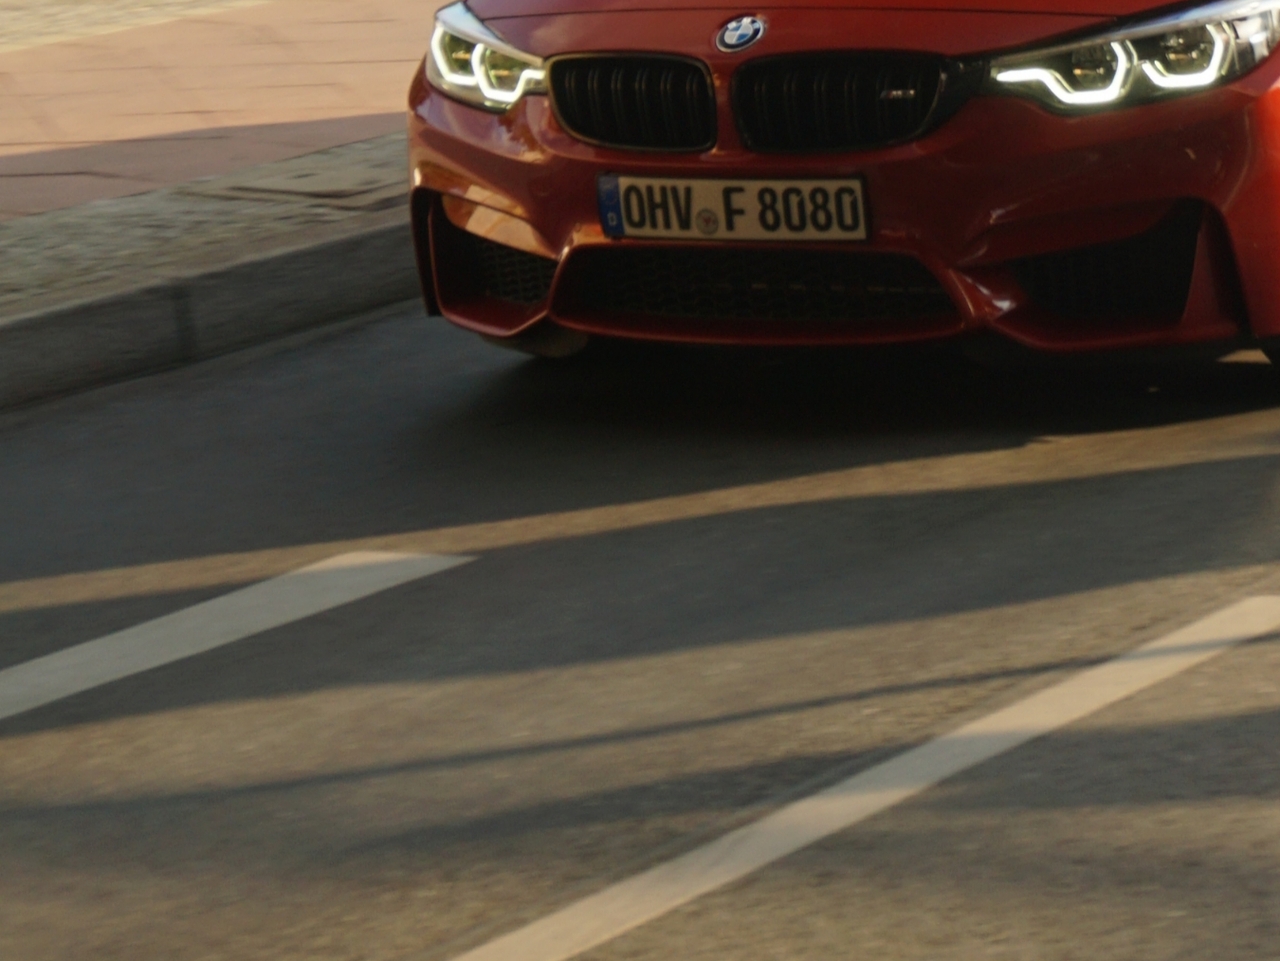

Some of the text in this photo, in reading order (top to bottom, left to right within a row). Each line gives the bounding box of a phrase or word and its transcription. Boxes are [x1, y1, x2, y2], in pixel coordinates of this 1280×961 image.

[623, 183, 860, 232] OHV F 8080
